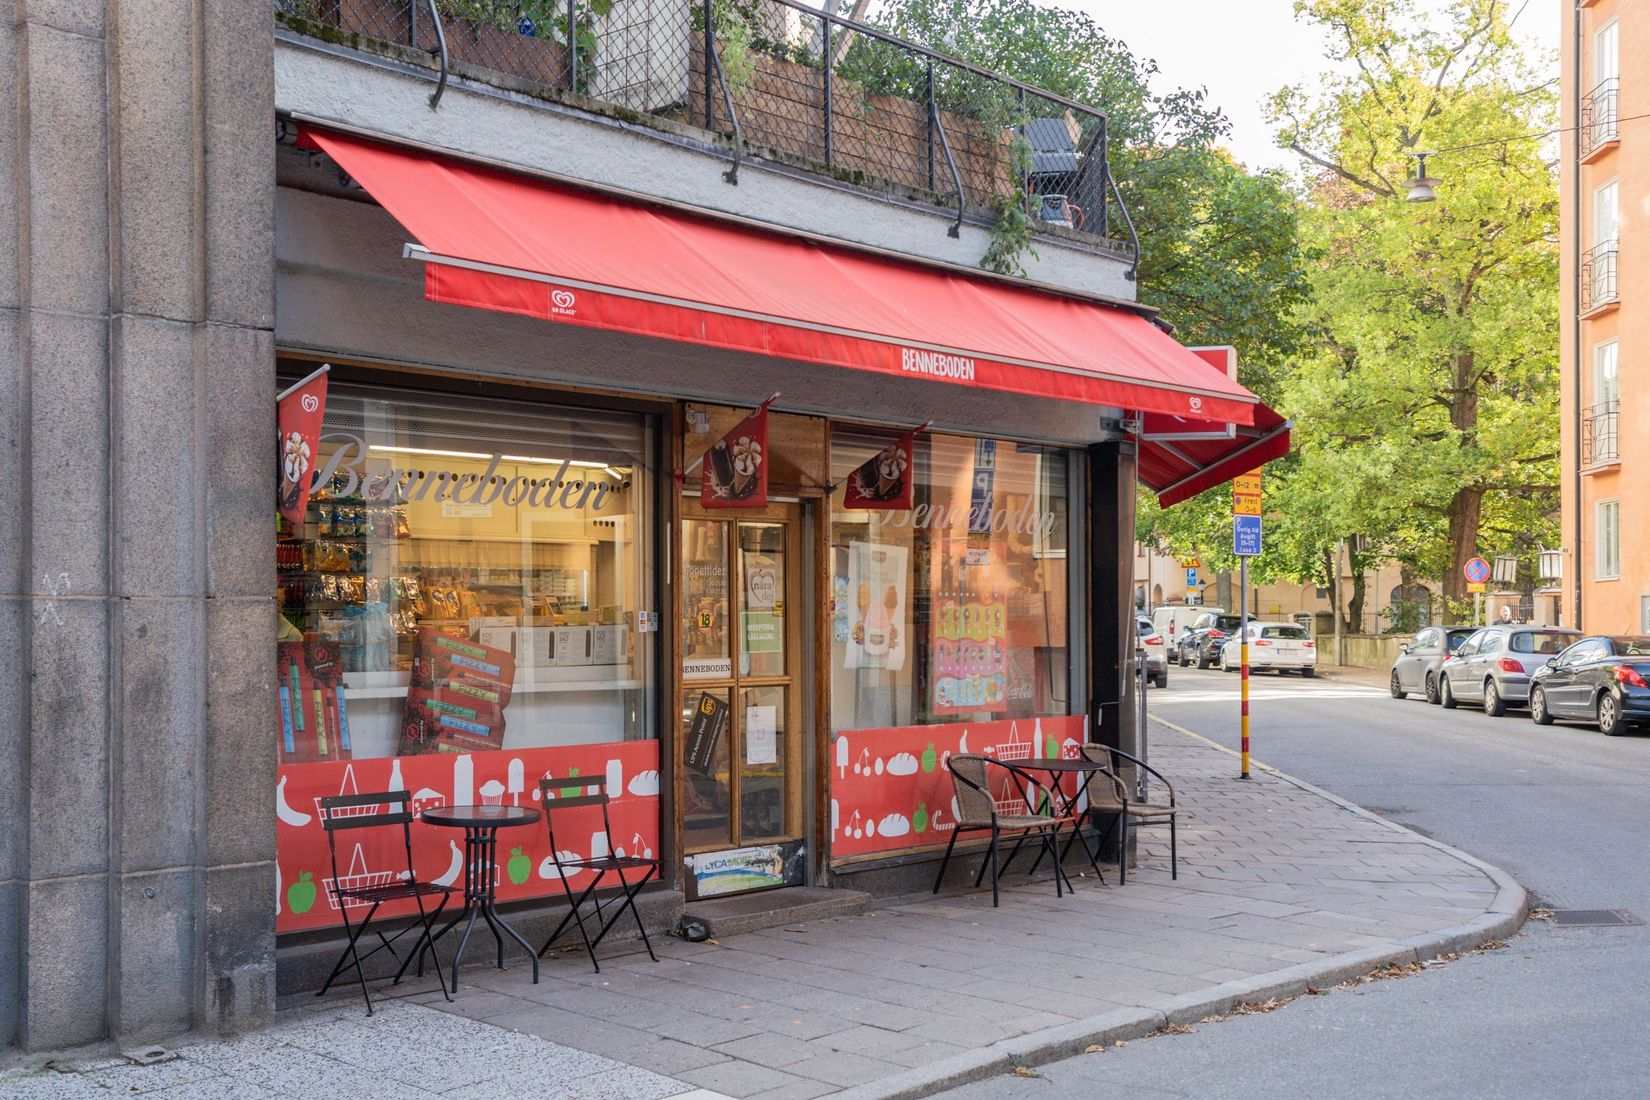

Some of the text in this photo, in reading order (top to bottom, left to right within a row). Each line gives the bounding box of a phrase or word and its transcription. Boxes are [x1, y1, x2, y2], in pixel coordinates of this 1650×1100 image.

[902, 347, 975, 380] BENNEBODEN
[310, 432, 610, 511] Benneboden
[1244, 496, 1258, 505] Fred
[701, 613, 711, 628] 18
[705, 699, 713, 714] ups
[315, 701, 325, 738] FIZZY
